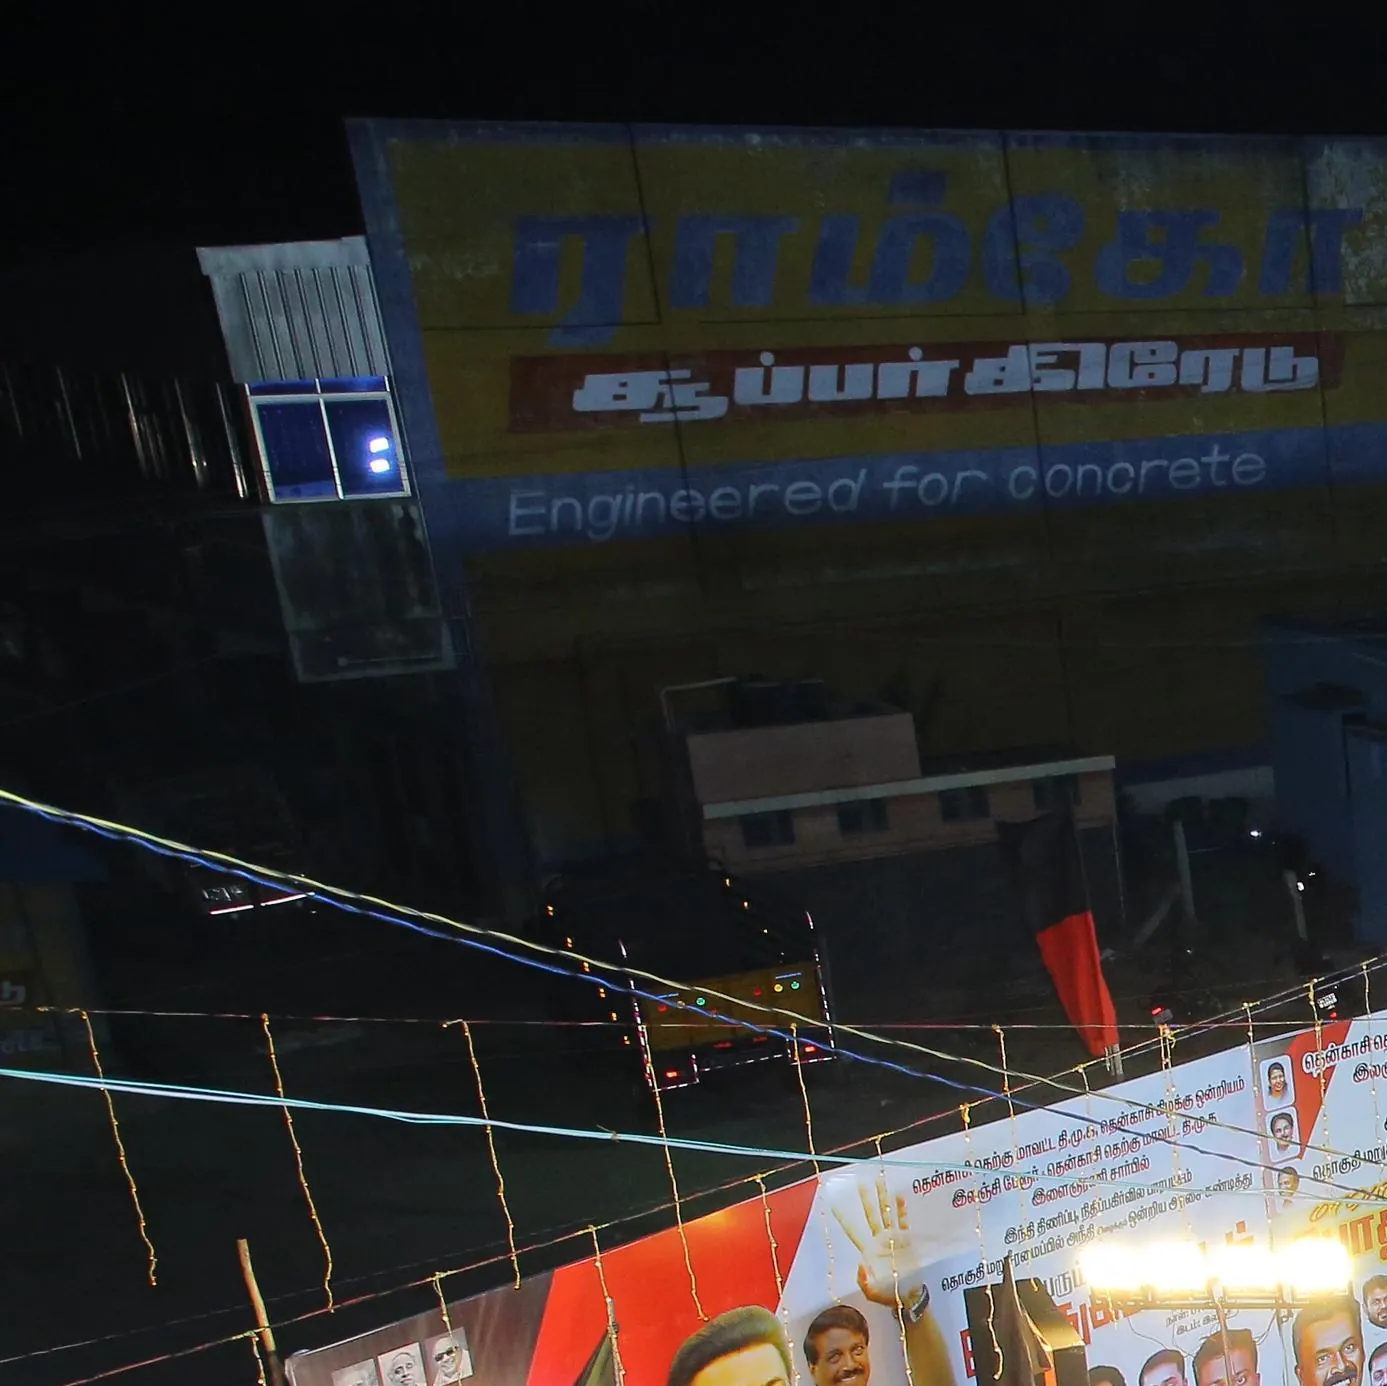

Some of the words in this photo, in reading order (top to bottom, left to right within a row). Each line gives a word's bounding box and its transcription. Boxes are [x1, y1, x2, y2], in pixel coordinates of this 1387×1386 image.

[507, 168, 1362, 348] ராம்கோ
[508, 464, 867, 537] Engineered
[882, 462, 987, 516] for
[1009, 440, 1266, 502] concrete
[1304, 1035, 1371, 1075] தென்காசி
[974, 1150, 1015, 1177] தெற்கு
[1016, 1137, 1057, 1162] மாவட்ட
[1100, 1102, 1155, 1136] தென்காசி
[1195, 1075, 1247, 1109] ஒன்றியம்
[1047, 1142, 1105, 1179] தென்காசி
[1104, 1131, 1142, 1161] தெற்கு
[1109, 1153, 1151, 1182] சார்பில்
[1312, 1149, 1362, 1182] தொகுதி
[941, 1260, 986, 1292] தொகுதி
[1066, 1221, 1096, 1248] அநீதி
[1127, 1195, 1168, 1228] ஒன்றிய
[1004, 1221, 1036, 1246] இந்தி
[1080, 1181, 1146, 1222] நிதிப்பகிர்வில்
